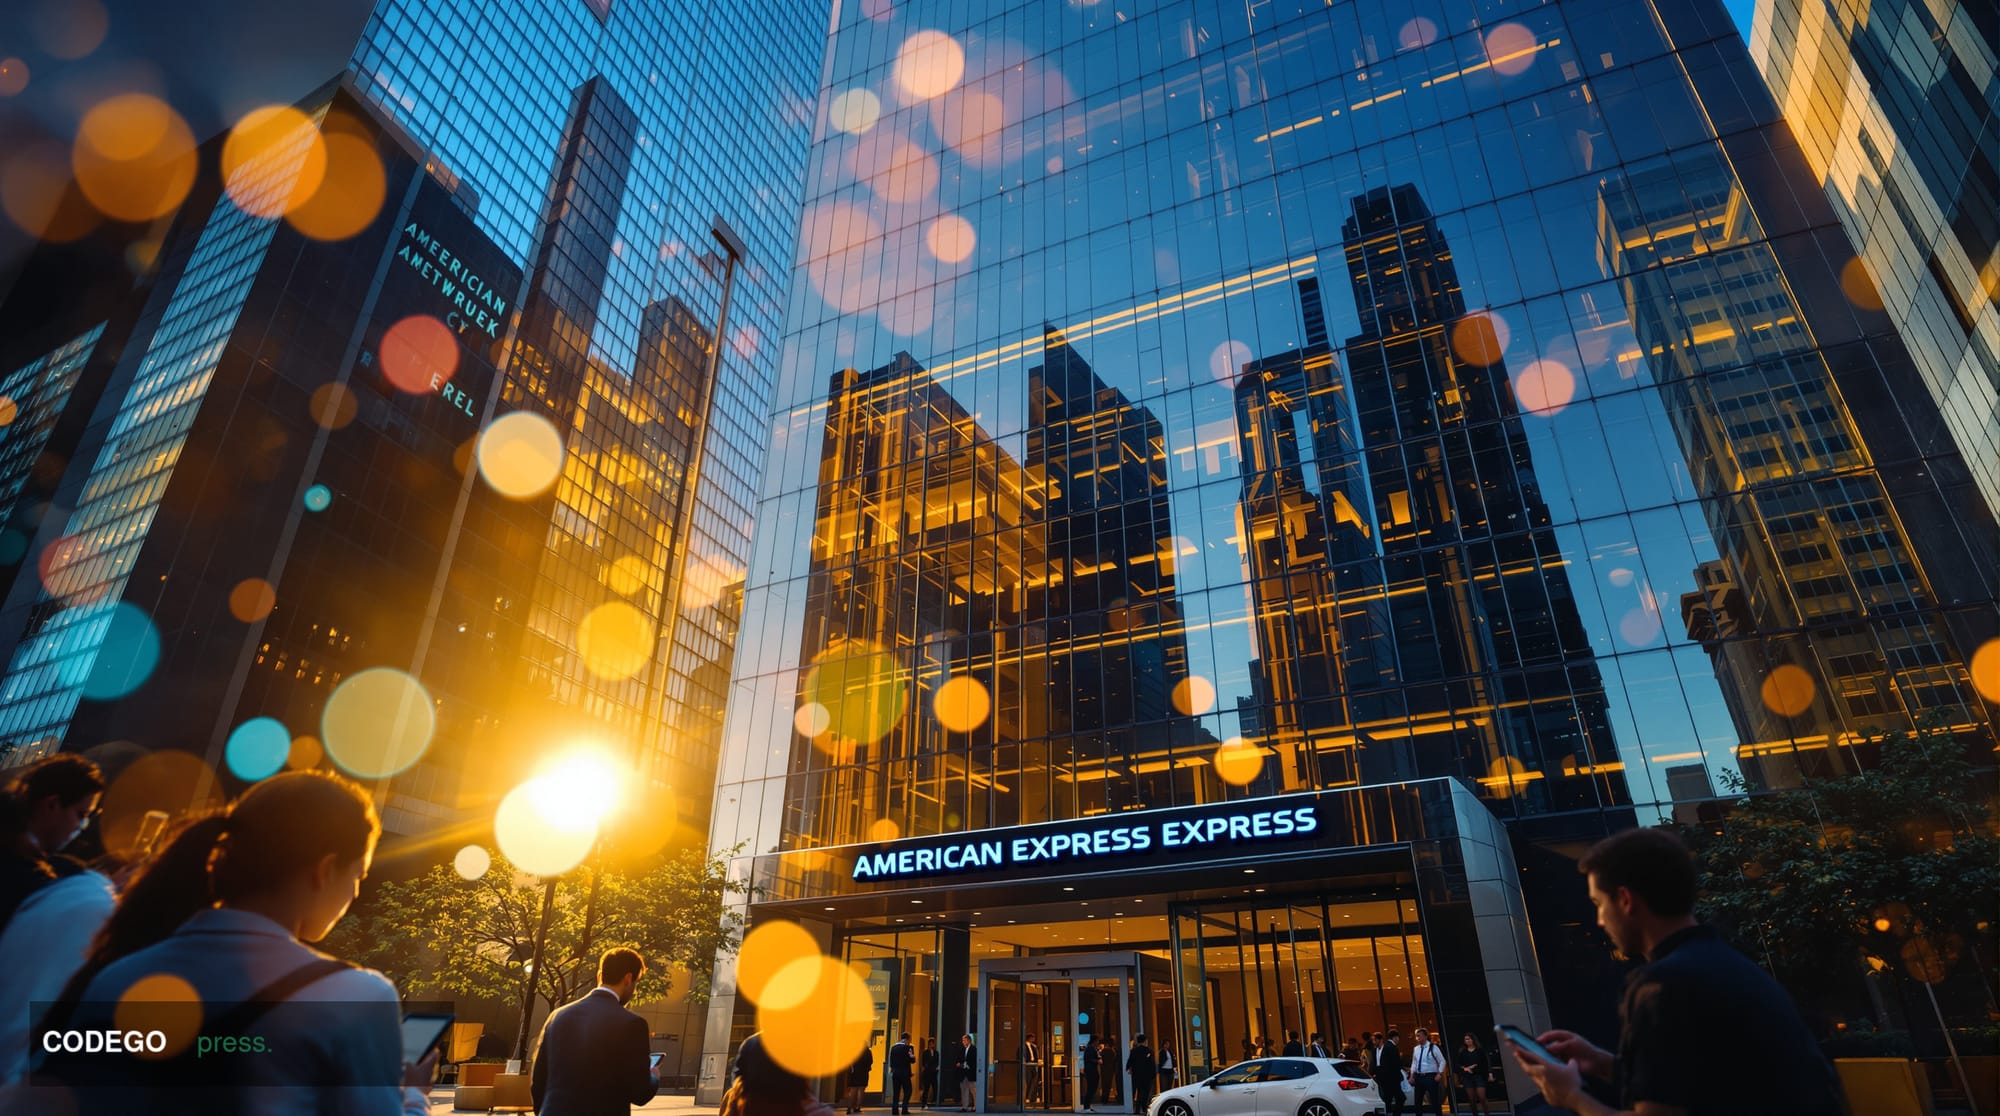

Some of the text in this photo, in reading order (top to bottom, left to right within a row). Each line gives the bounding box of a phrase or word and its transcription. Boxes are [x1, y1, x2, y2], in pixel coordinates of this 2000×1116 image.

[405, 223, 506, 316] AMEERICIAN
[852, 807, 1318, 878] AMERICAN EXPRESS EXPRESS
